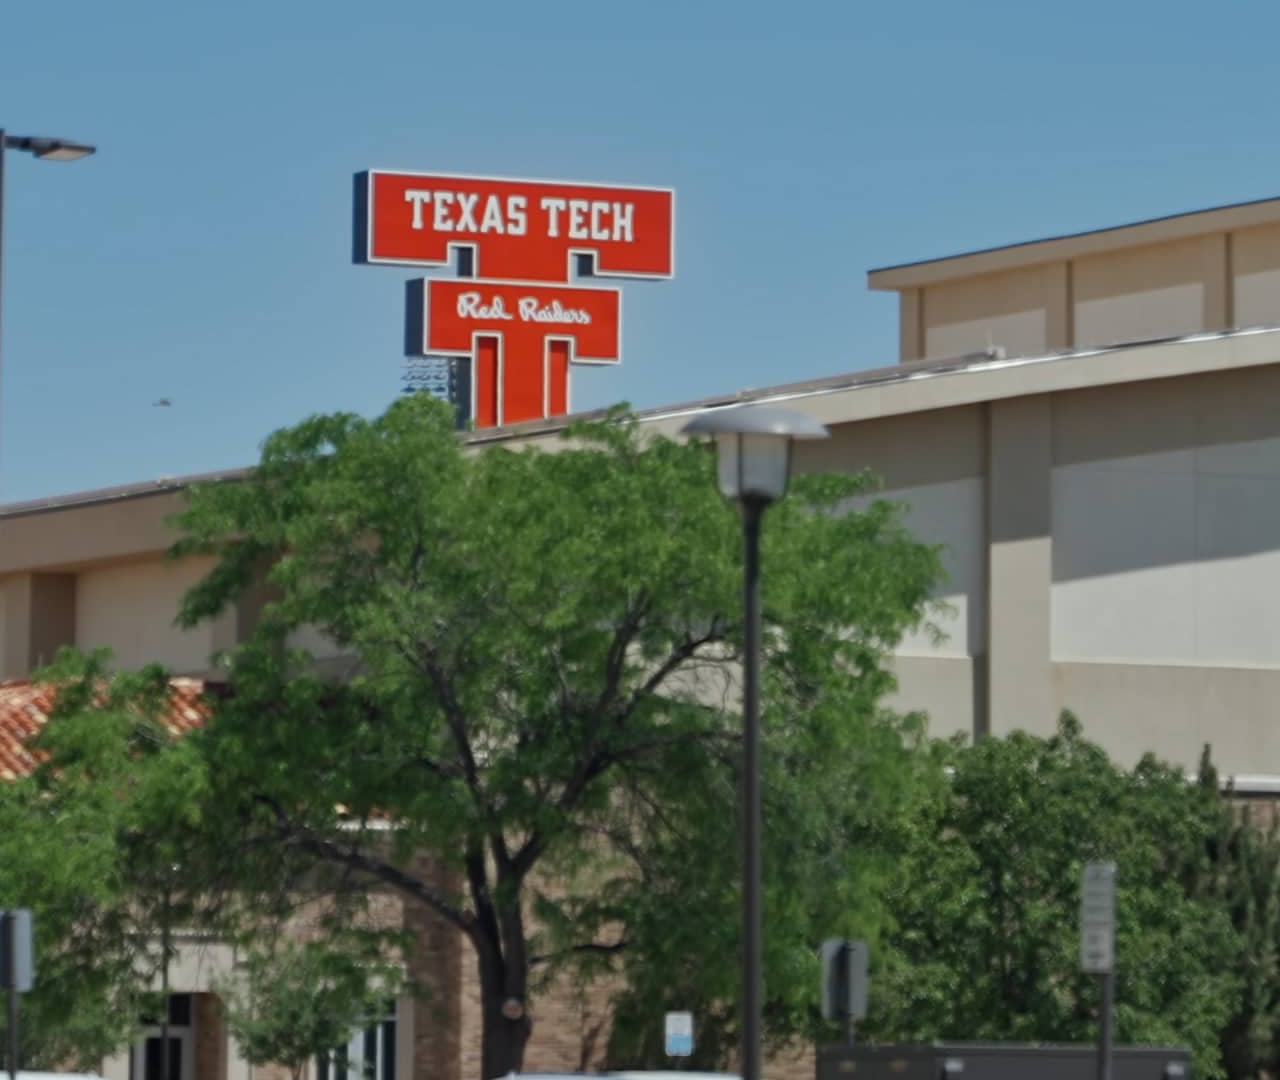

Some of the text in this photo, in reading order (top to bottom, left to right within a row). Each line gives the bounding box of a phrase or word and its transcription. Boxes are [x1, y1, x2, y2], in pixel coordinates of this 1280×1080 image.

[404, 189, 635, 242] TEXAS TECH
[456, 291, 591, 325] Red Raiders
